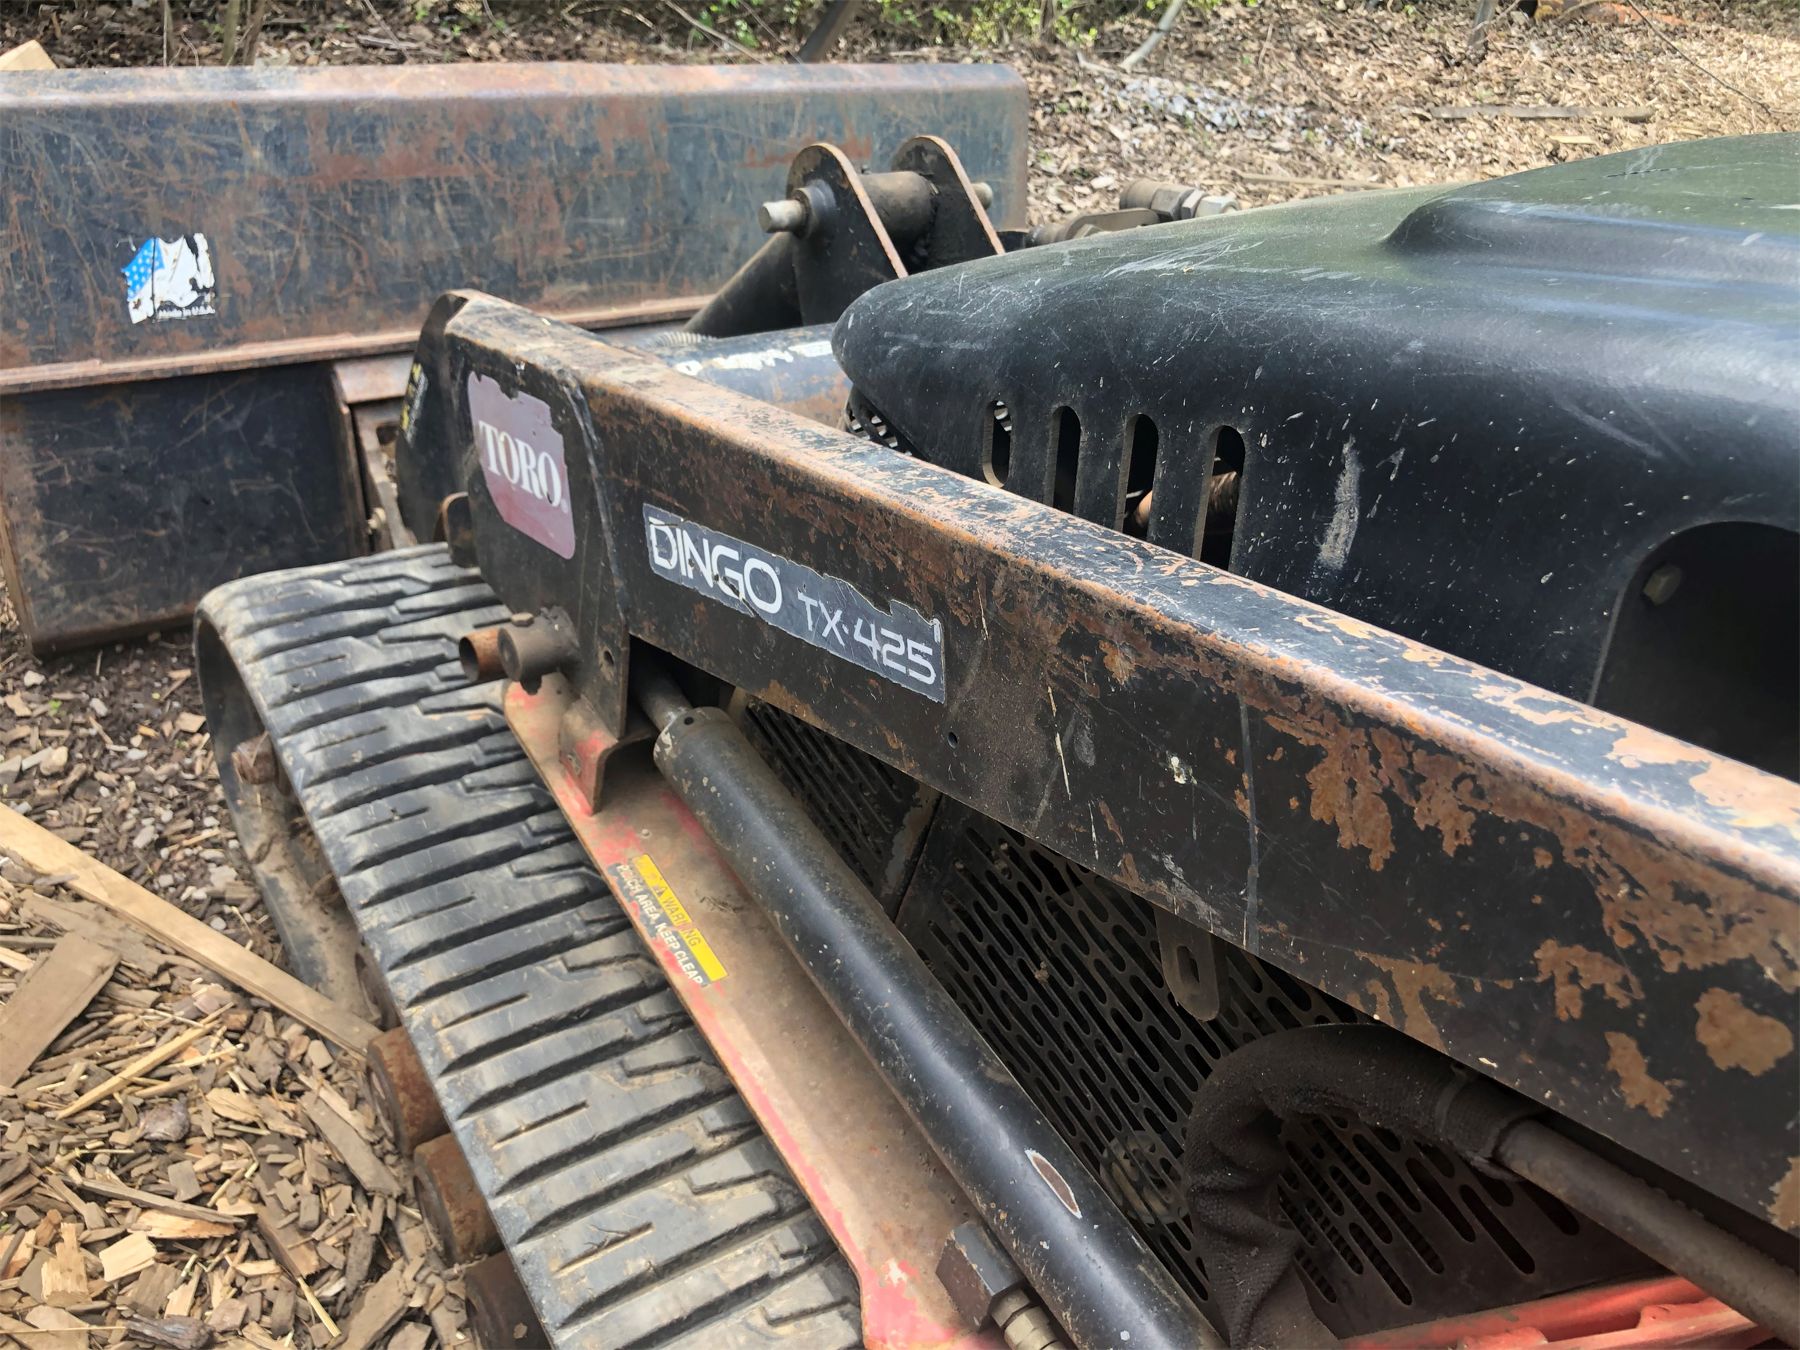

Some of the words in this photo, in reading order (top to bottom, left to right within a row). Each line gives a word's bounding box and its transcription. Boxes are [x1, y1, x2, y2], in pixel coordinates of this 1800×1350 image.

[479, 420, 561, 507] TORO
[648, 516, 783, 614] DINGO
[616, 864, 643, 897] PCH
[655, 922, 681, 951] KEEP
[663, 897, 702, 947] WARNG
